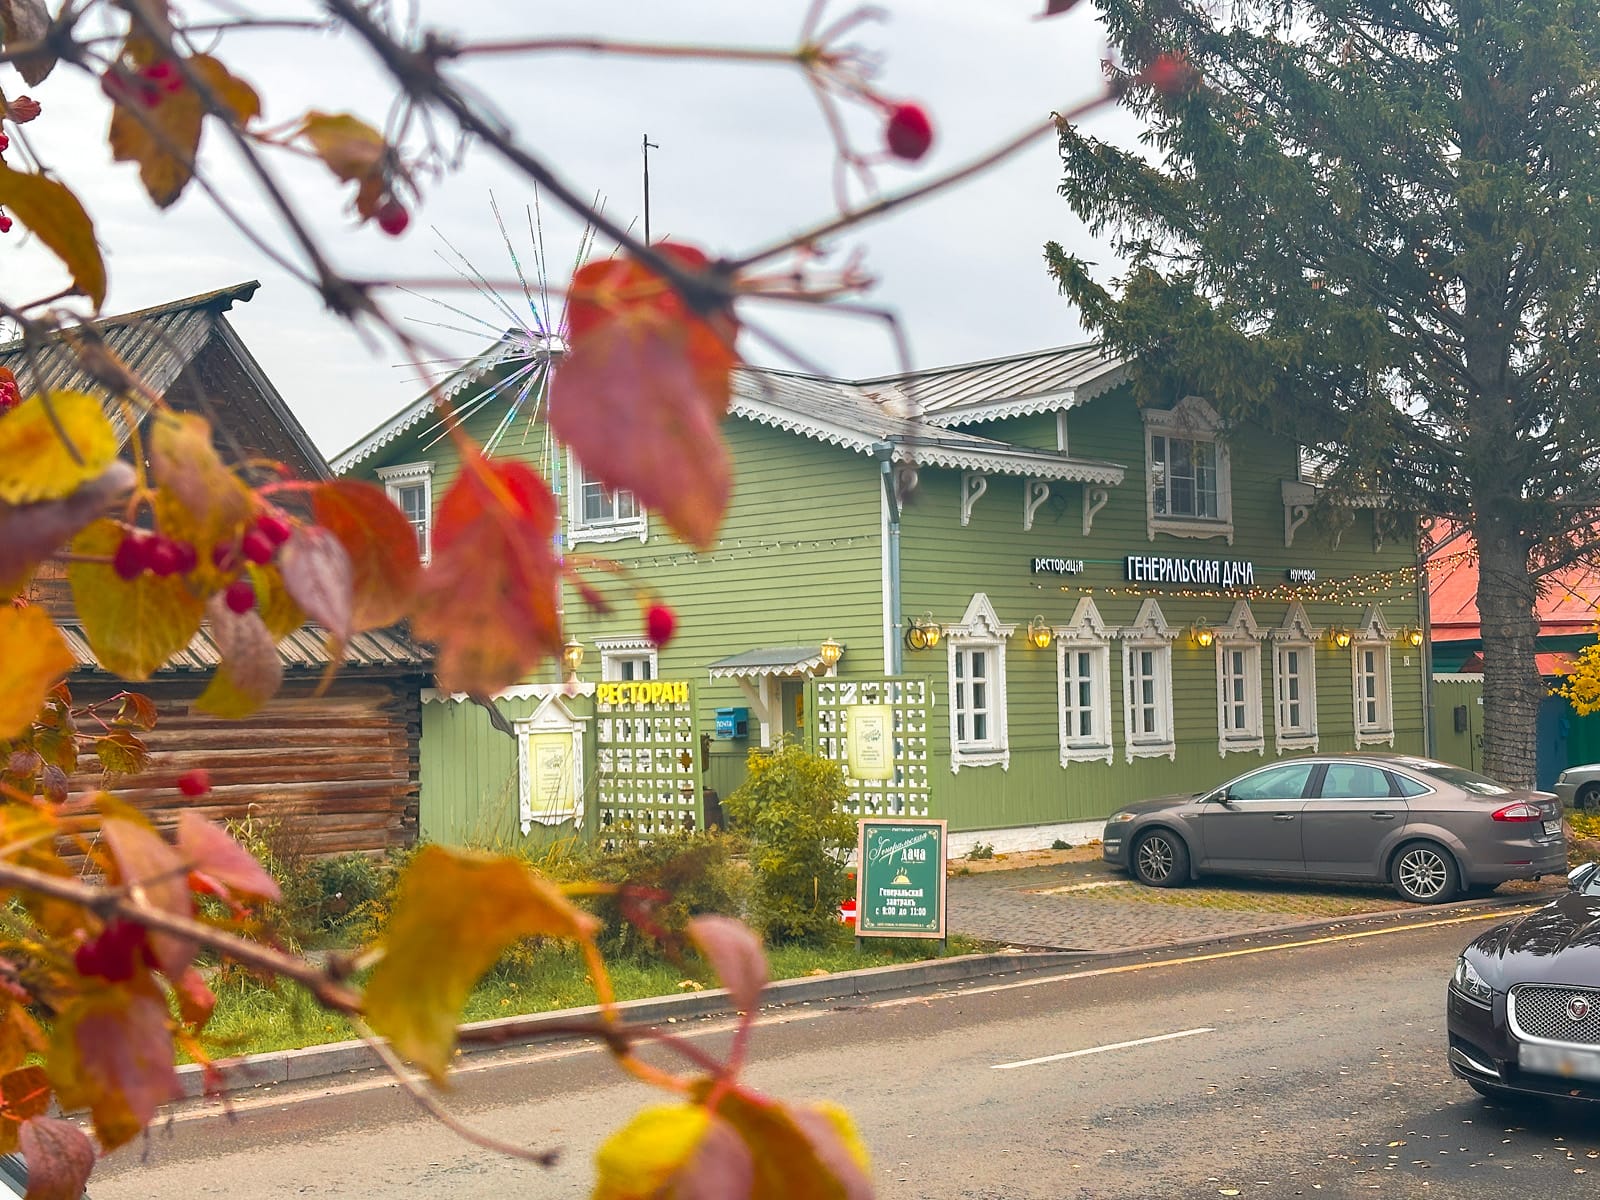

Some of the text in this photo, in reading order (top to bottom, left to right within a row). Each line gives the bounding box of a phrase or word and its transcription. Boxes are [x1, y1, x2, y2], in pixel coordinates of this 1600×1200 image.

[1127, 556, 1254, 588] ГЕНЕРАЛЬСКАЯ ДАЧА
[1290, 568, 1316, 582] нумера
[597, 682, 689, 704] РЕСТОРАН
[910, 907, 926, 916] 11:00
